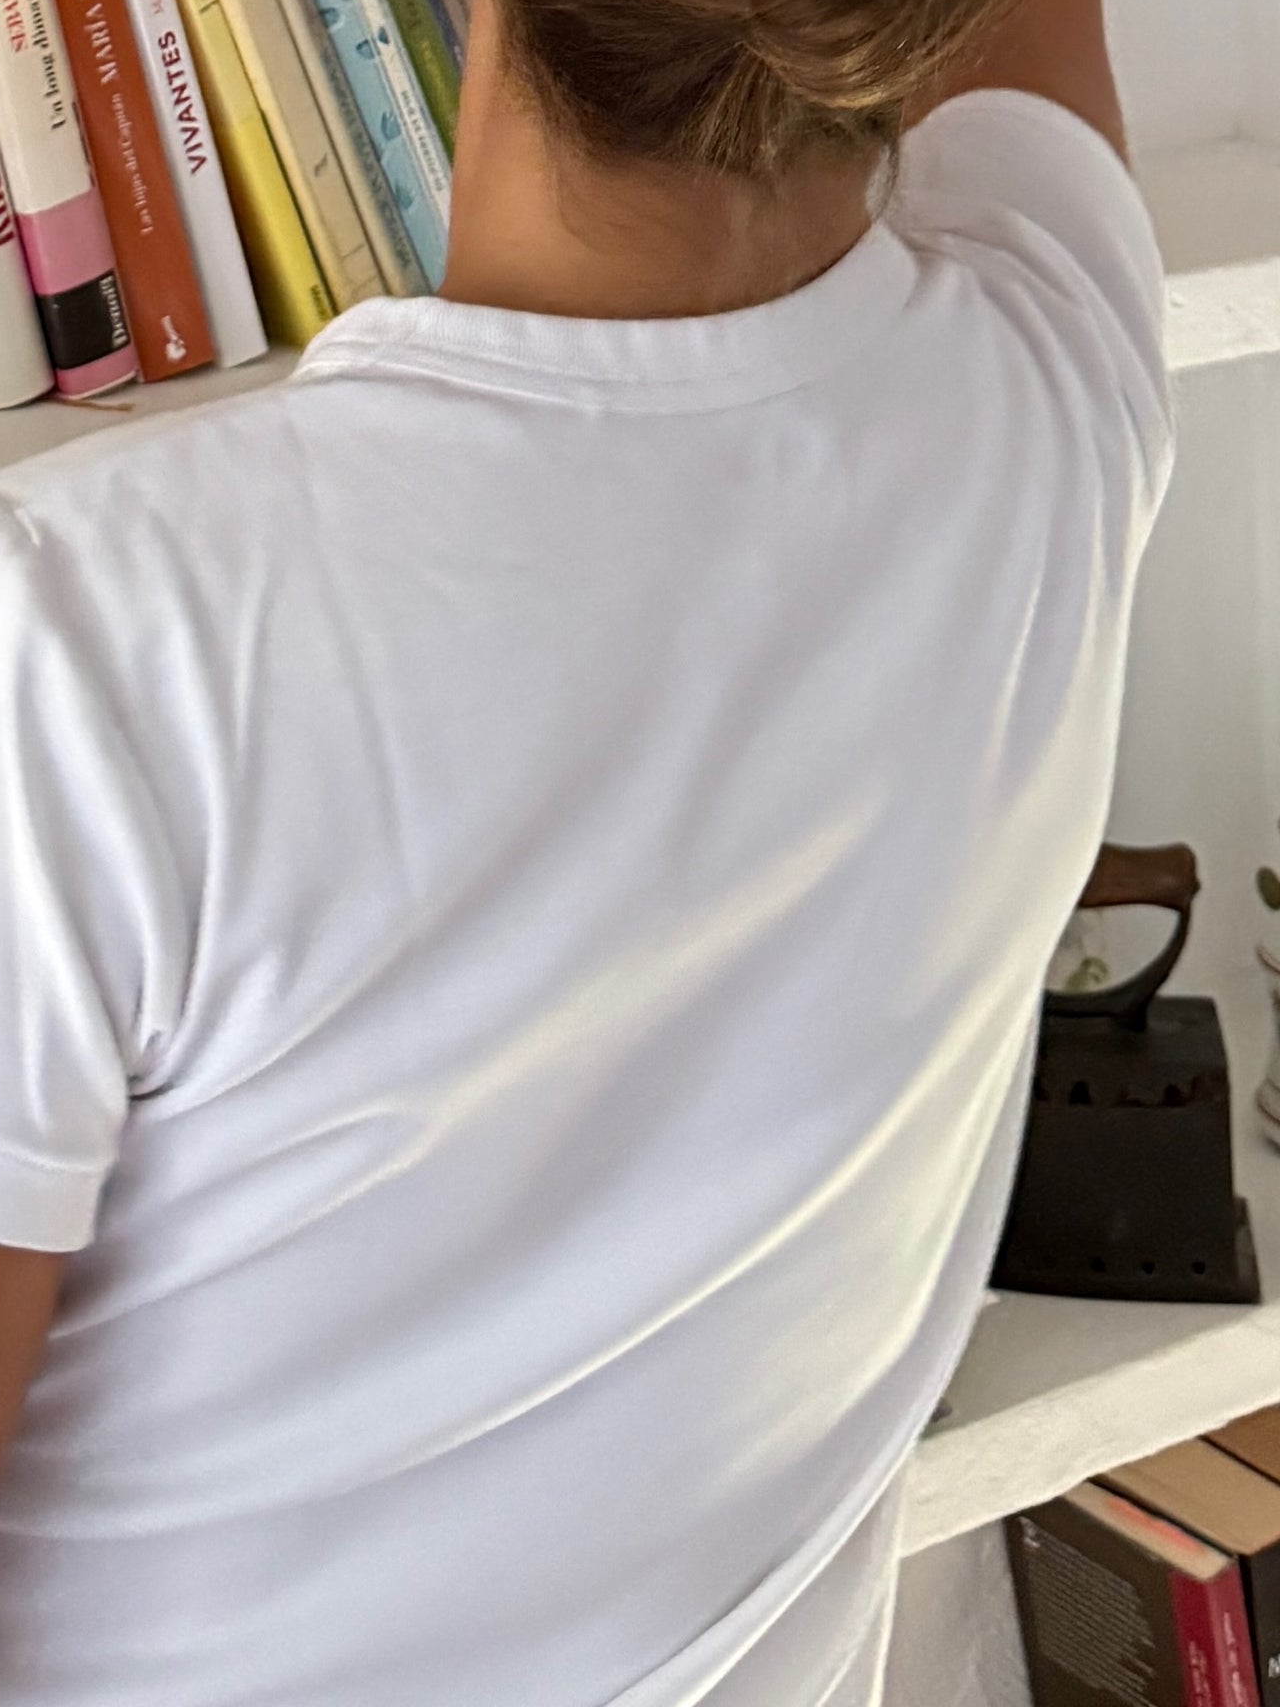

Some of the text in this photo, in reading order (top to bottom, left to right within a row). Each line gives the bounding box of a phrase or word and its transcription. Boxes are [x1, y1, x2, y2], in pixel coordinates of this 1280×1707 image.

[85, 1, 121, 84] MARÍA
[38, 53, 63, 98] long
[158, 31, 210, 175] VIVANTES
[49, 102, 68, 130] Un
